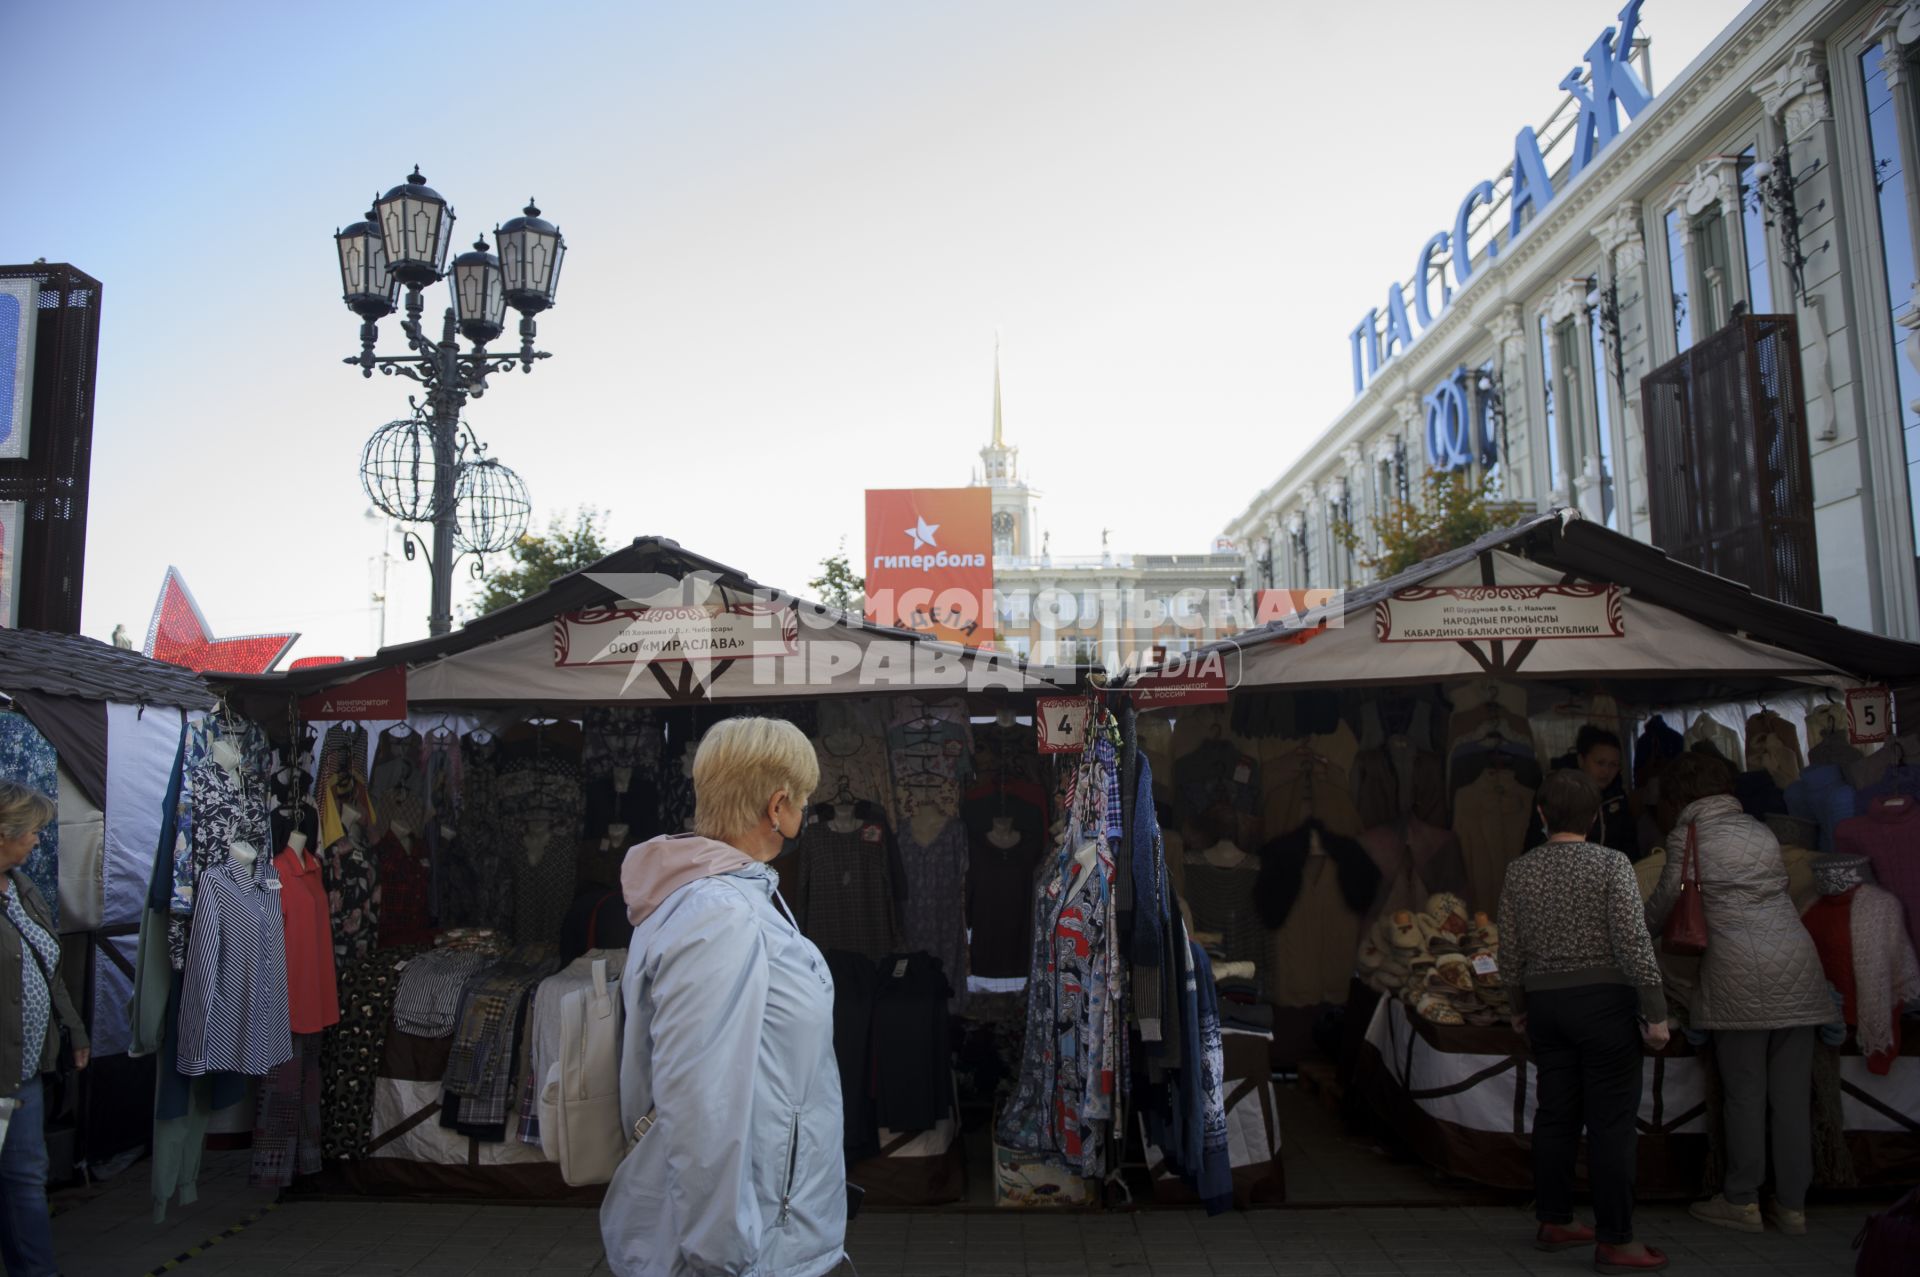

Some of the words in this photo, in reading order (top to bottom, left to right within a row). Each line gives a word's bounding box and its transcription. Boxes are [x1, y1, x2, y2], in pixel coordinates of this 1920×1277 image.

[1350, 0, 1653, 397] ПАССАЖ
[873, 550, 986, 572] гипербола
[1443, 615, 1498, 626] НАРОДНЫЕ
[1500, 614, 1559, 624] ПРОМЫСЛЫ
[692, 625, 733, 634] Чебоксары
[1404, 625, 1532, 638] КАБАРДИНО-БАЛКАРСКОЙ
[1534, 624, 1600, 635] РЕСПУБЛИКИ
[608, 642, 639, 655] ООО
[643, 637, 745, 653] «МИРАСЛАВА»
[1154, 682, 1209, 692] МИНПРОМТОРГ
[1154, 691, 1186, 699] РОССИИ
[336, 698, 390, 706] МИНПРОМТОРГ
[336, 705, 367, 713] РОССИИ
[1863, 704, 1876, 726] 5
[1057, 713, 1073, 735] 4
